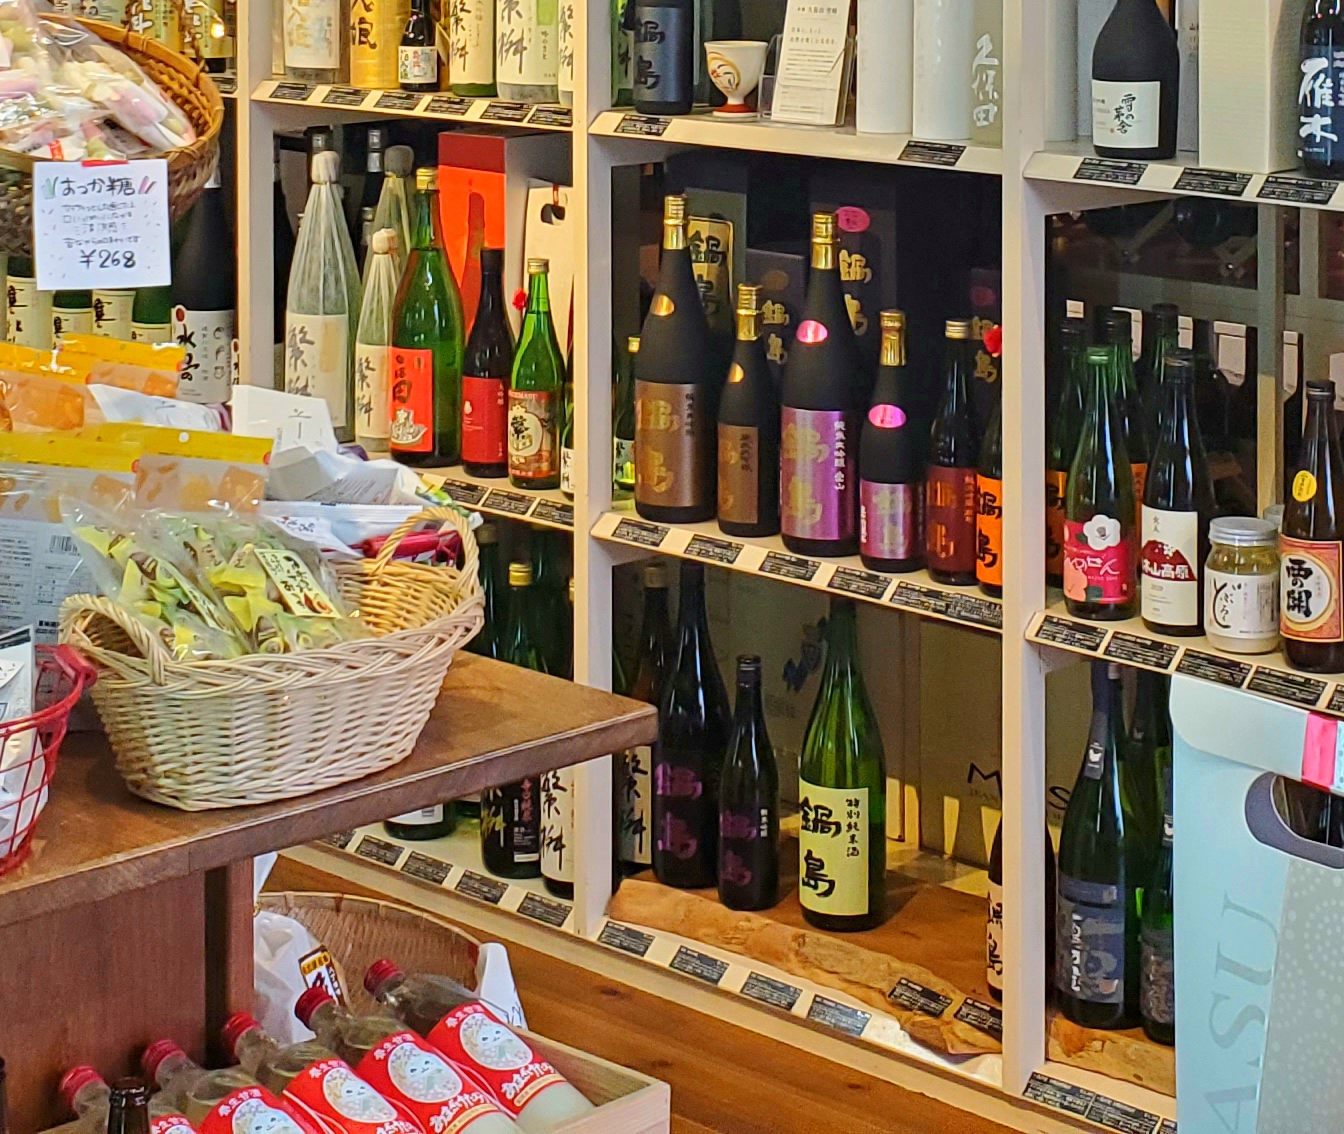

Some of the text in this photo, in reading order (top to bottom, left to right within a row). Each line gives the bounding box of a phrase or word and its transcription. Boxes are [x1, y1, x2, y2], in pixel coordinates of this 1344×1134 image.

[1297, 56, 1339, 144] 雁木
[78, 249, 136, 269] ¥268
[799, 796, 842, 898] 鍋島
[845, 797, 861, 857] 特別純米酒
